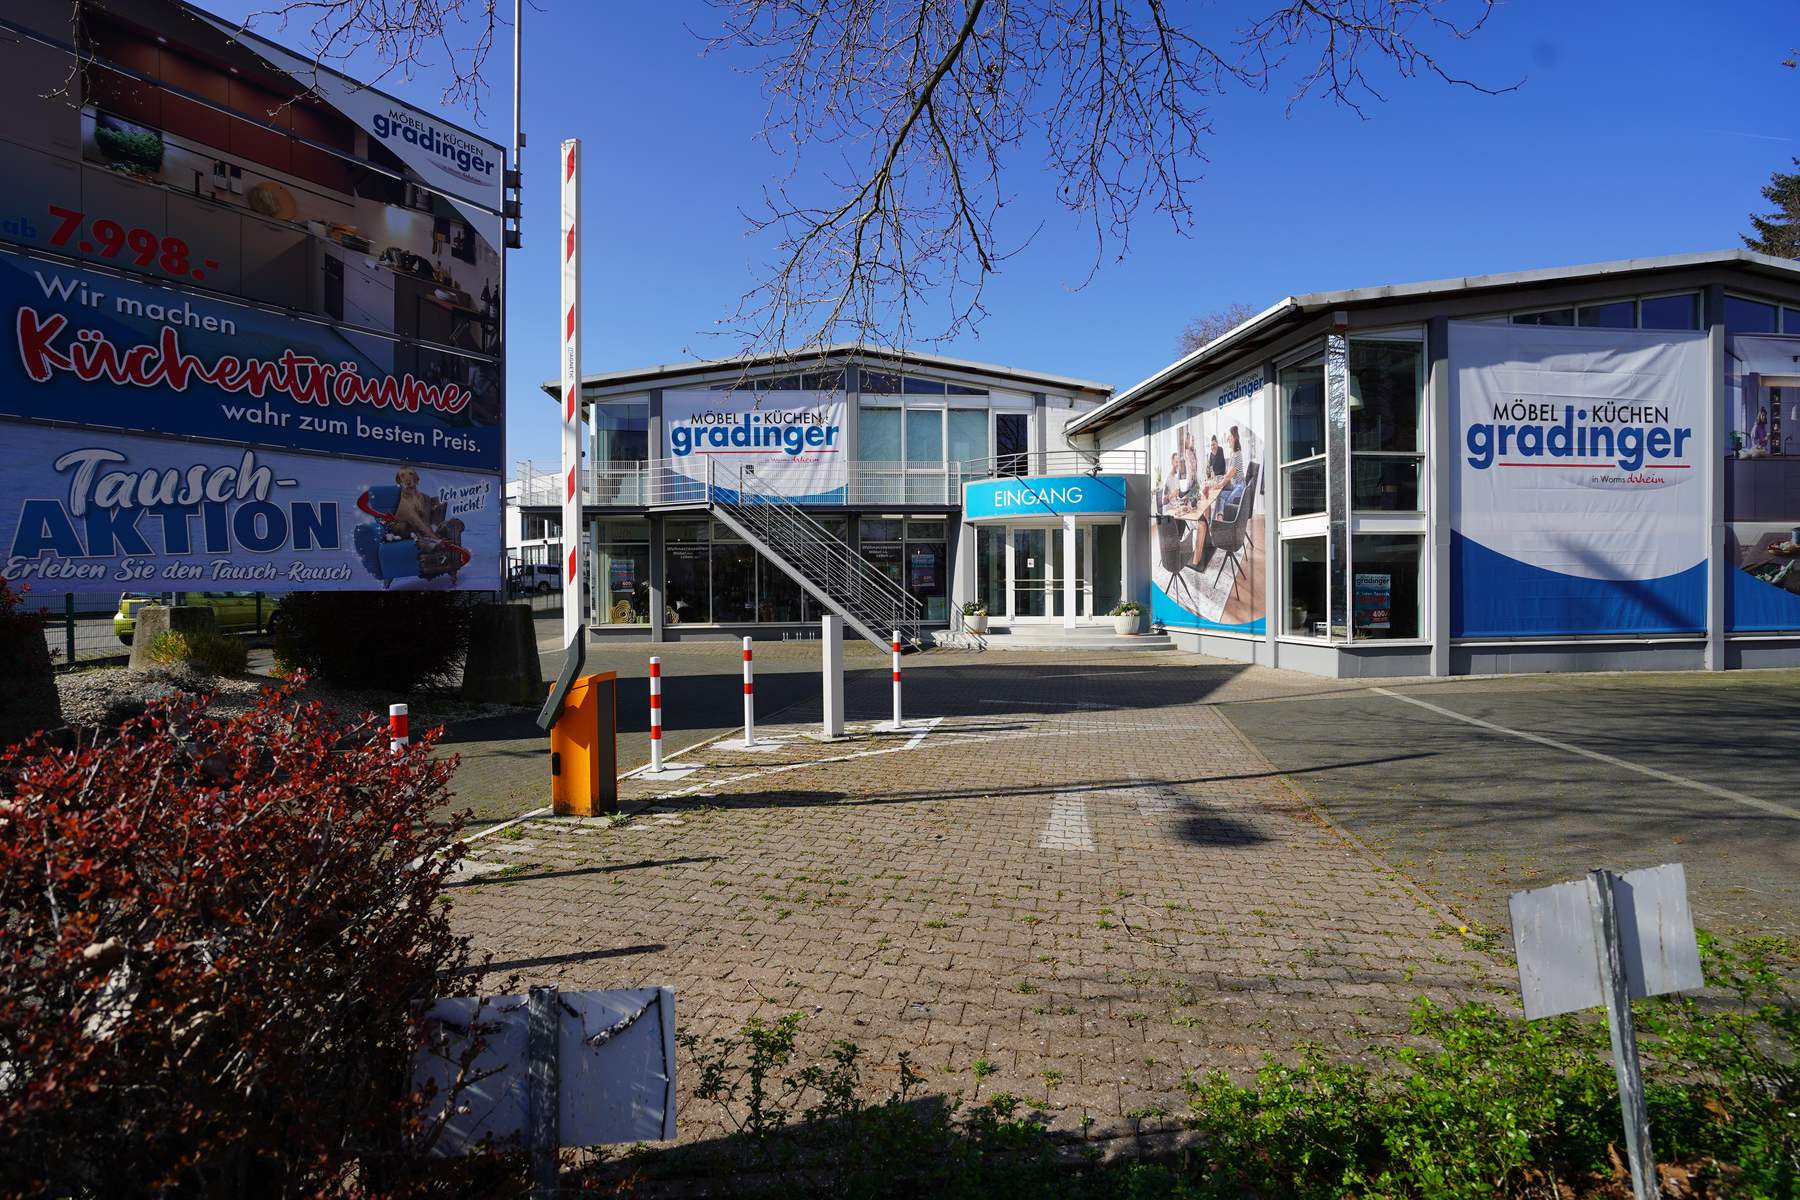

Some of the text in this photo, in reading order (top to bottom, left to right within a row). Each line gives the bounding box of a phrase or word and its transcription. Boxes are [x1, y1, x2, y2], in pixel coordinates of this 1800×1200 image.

[373, 113, 494, 176] gradinger
[388, 108, 484, 158] MÖBEL KÜCHEN
[3, 215, 38, 240] ab
[34, 270, 236, 336] Wir machen
[17, 307, 472, 414] Küchenträume
[1218, 377, 1264, 409] gradinger
[1493, 399, 1669, 423] MÖBEL KÜCHEN
[221, 402, 481, 453] wahr zum besten Preis.
[671, 414, 839, 456] gradinger
[691, 410, 822, 425] MÖBEL KÜCHEN
[1467, 405, 1691, 471] gradinger
[54, 448, 298, 517] Tausch-
[440, 488, 457, 503] Ich
[994, 486, 1083, 507] EINGANG
[1592, 473, 1665, 484] in Worms daheim
[453, 496, 485, 514] nicht!
[9, 499, 342, 559] AKTION
[1, 556, 352, 582] Erleben Sie den Tausch-Rausch
